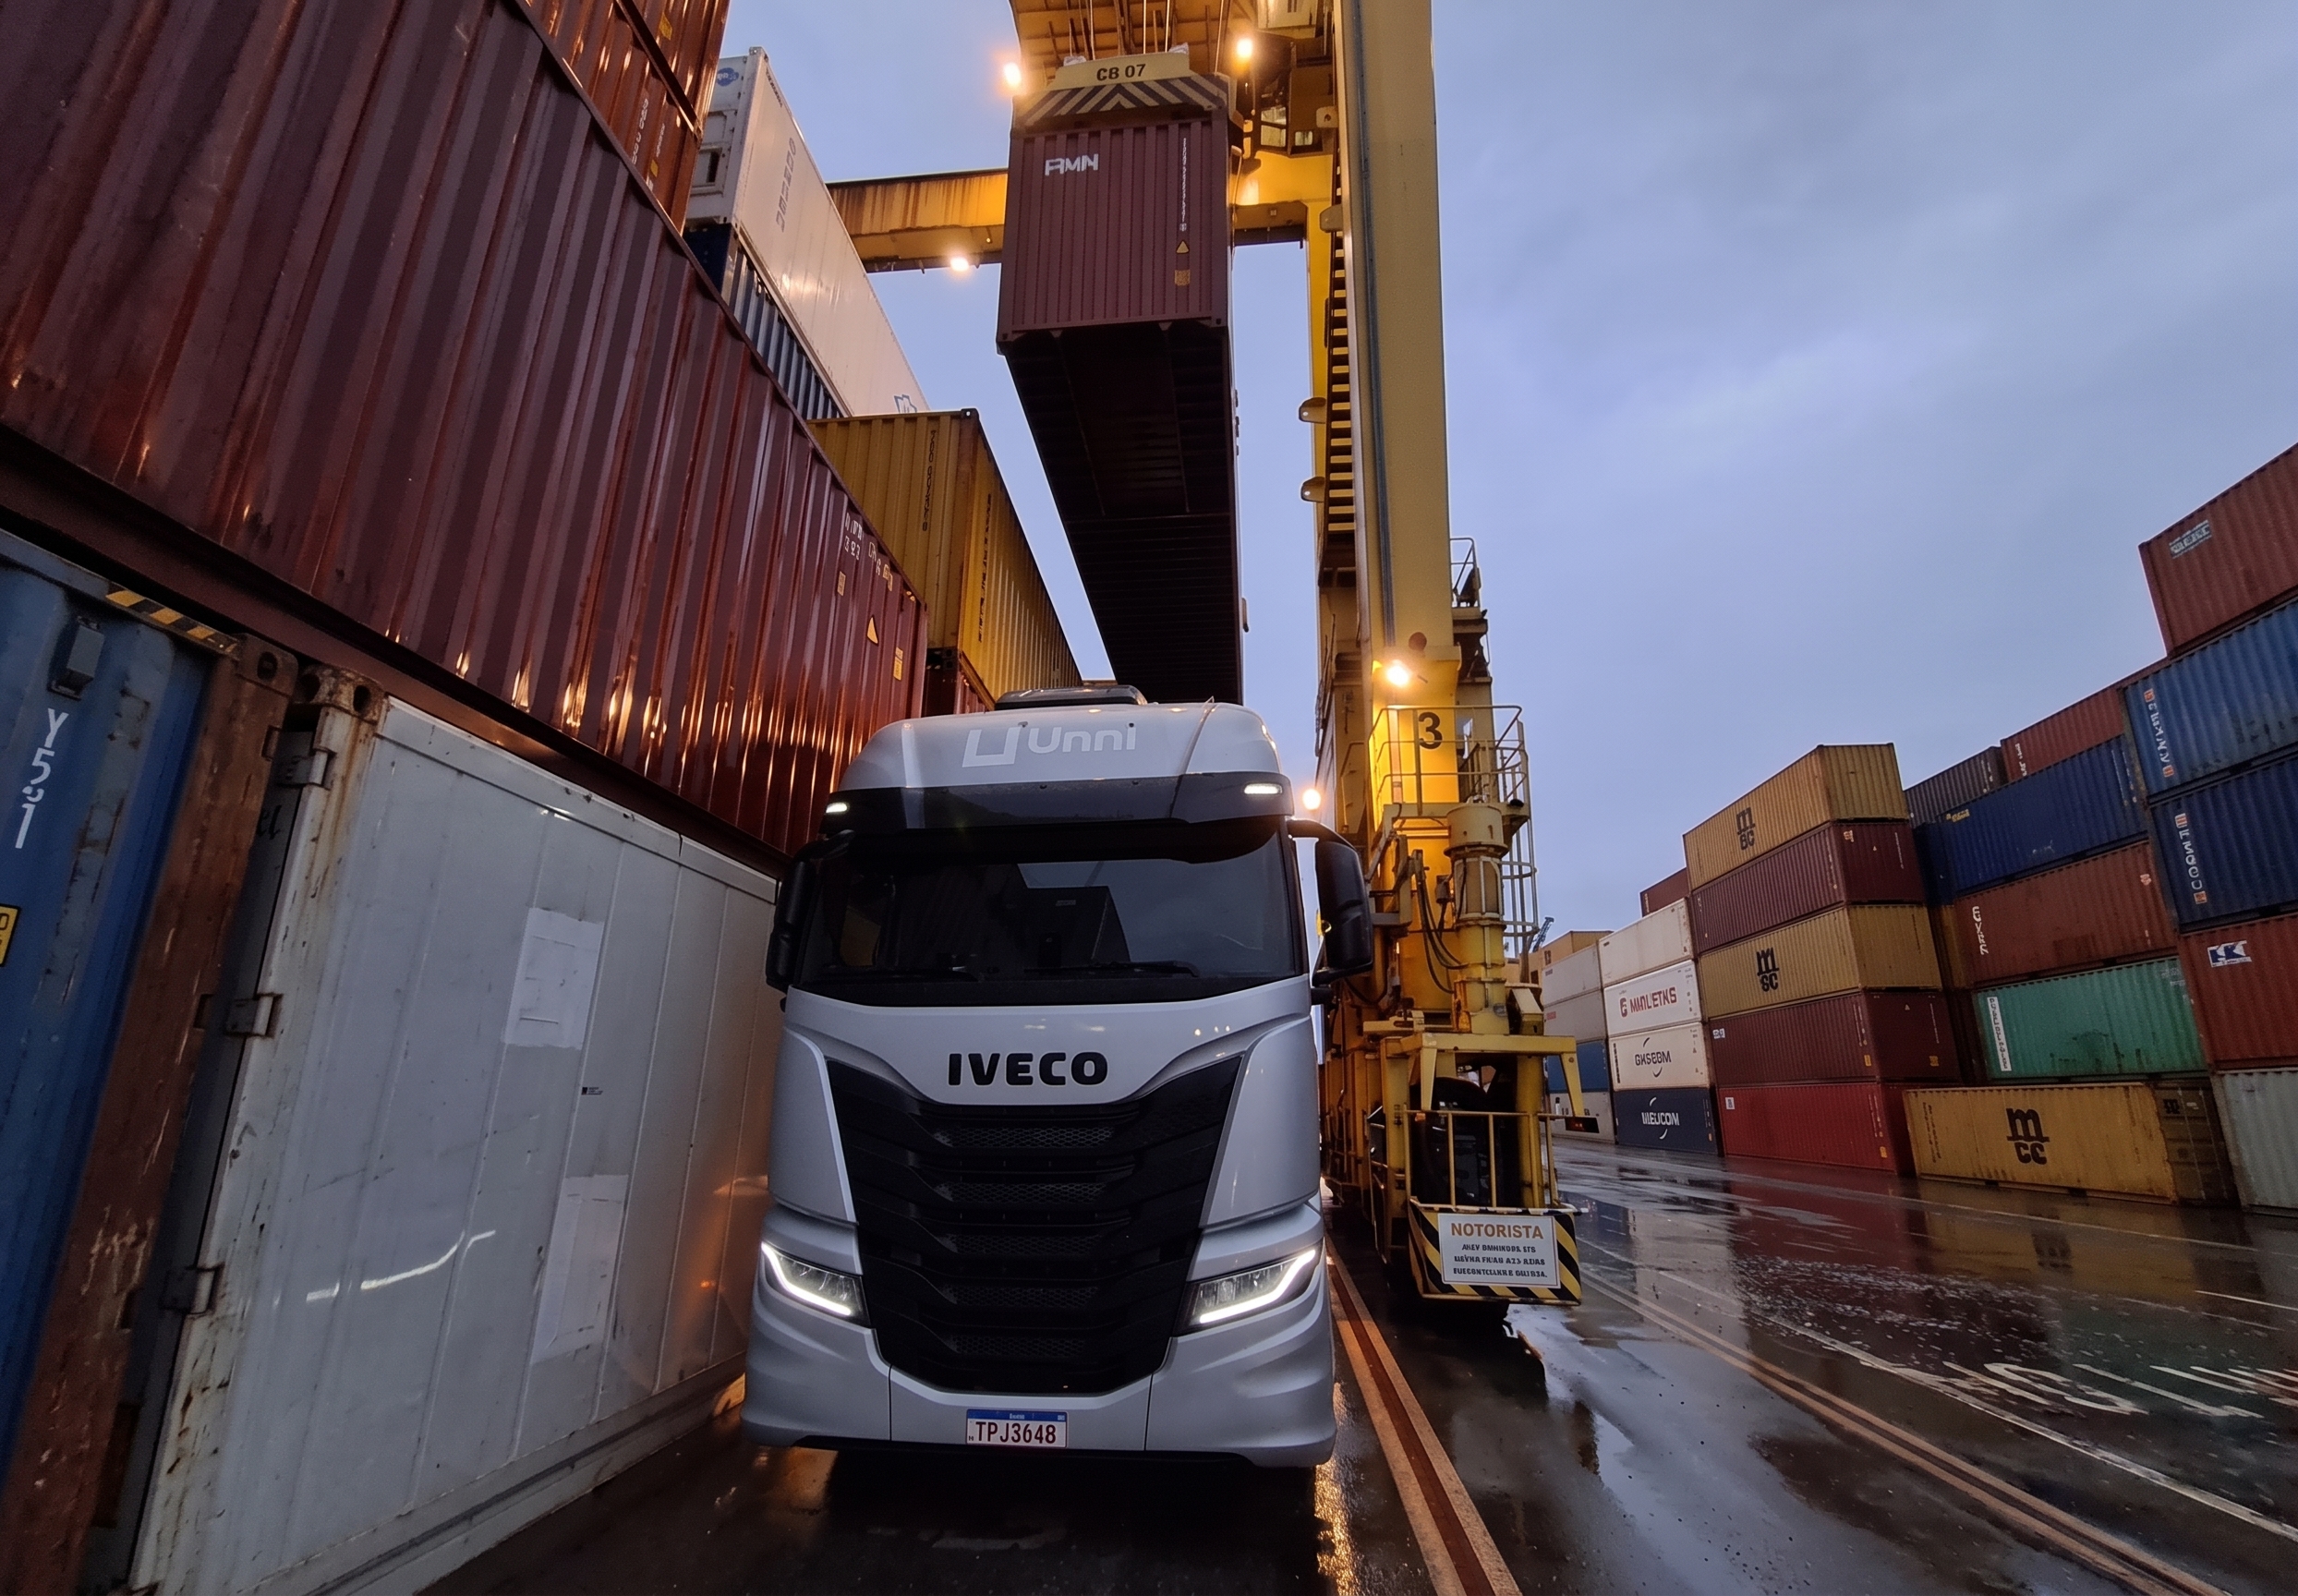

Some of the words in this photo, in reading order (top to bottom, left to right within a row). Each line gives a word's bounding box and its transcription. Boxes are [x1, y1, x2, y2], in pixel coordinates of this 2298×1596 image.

[1124, 63, 1146, 79] 07
[1027, 726, 1137, 755] Unni
[1418, 711, 1443, 750] 3
[948, 1051, 1108, 1086] IVECO
[1451, 1223, 1543, 1239] NOTORISTA
[975, 1421, 1057, 1445] TPJ3648
